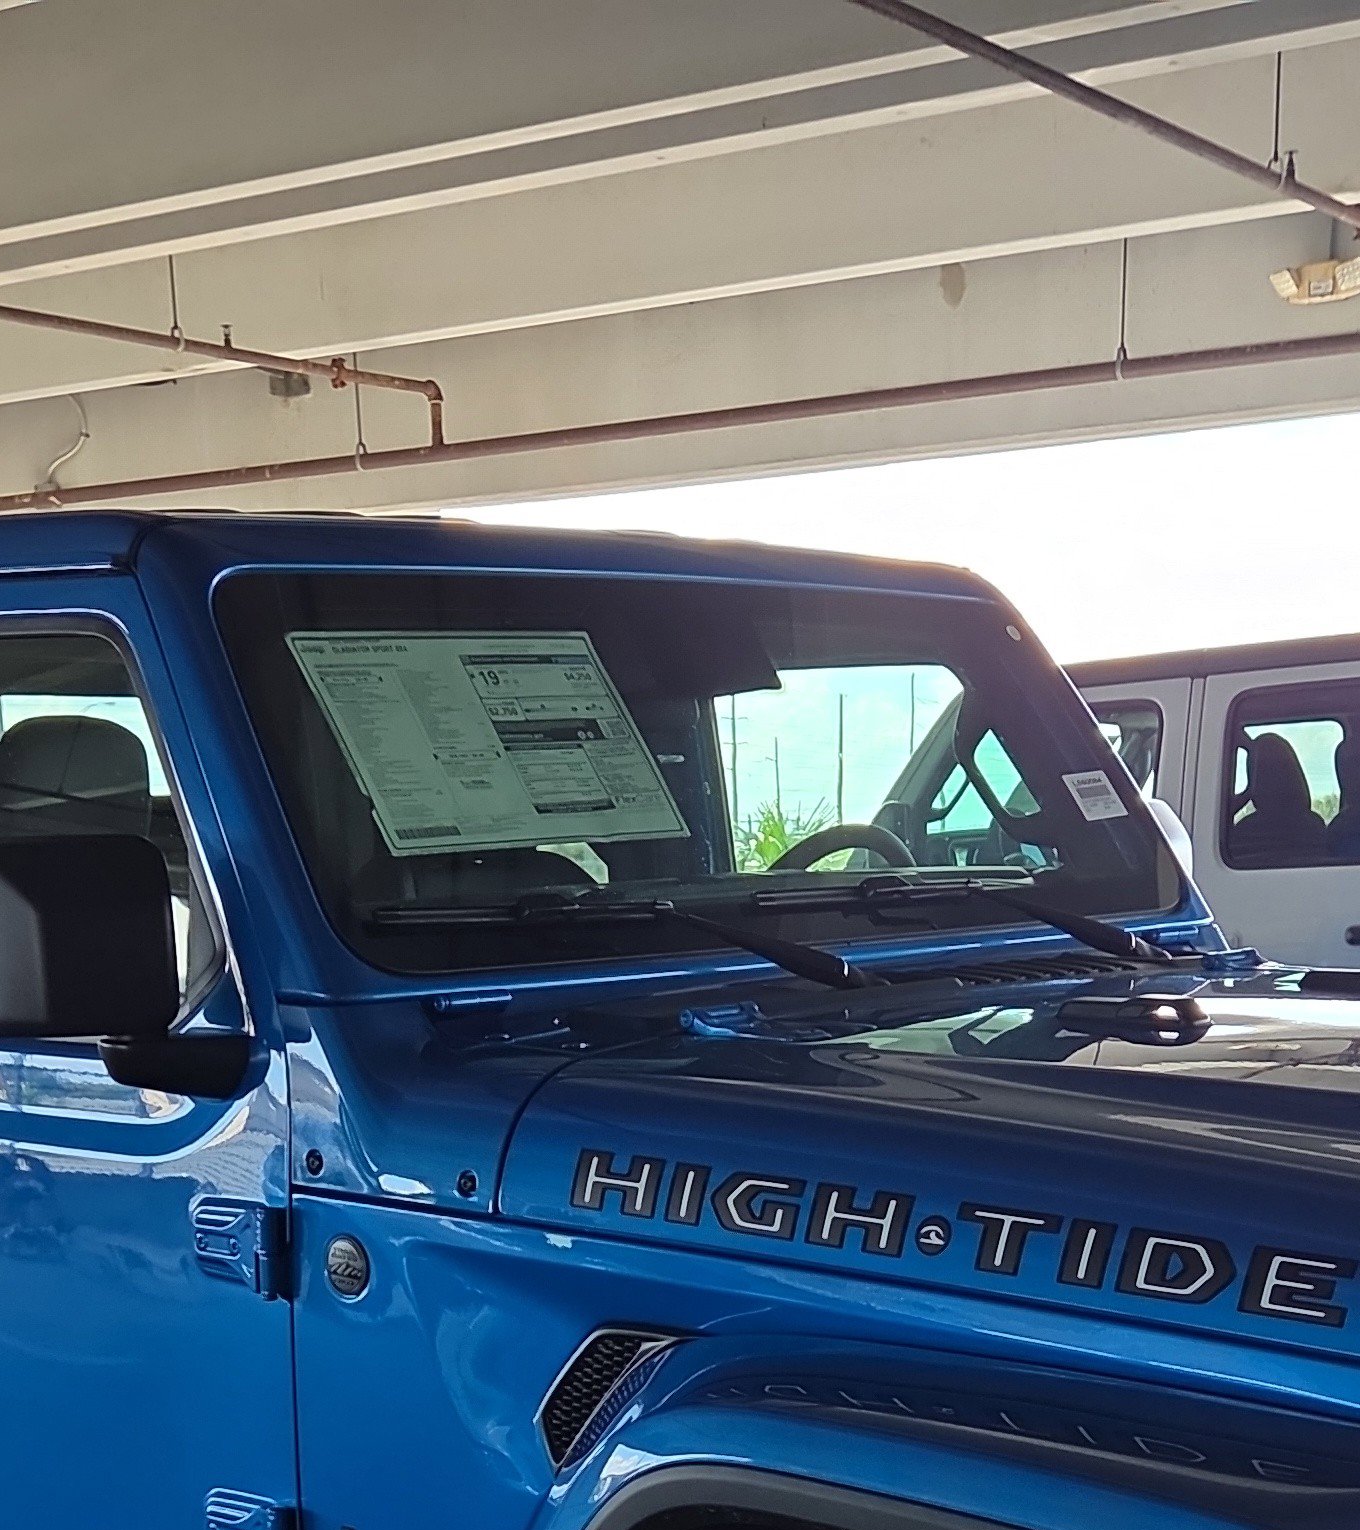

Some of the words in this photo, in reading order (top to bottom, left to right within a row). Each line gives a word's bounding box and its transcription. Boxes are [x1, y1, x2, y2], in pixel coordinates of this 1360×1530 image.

[478, 670, 500, 686] 19
[571, 1148, 914, 1257] HIGH
[957, 1202, 1358, 1327] TIDE
